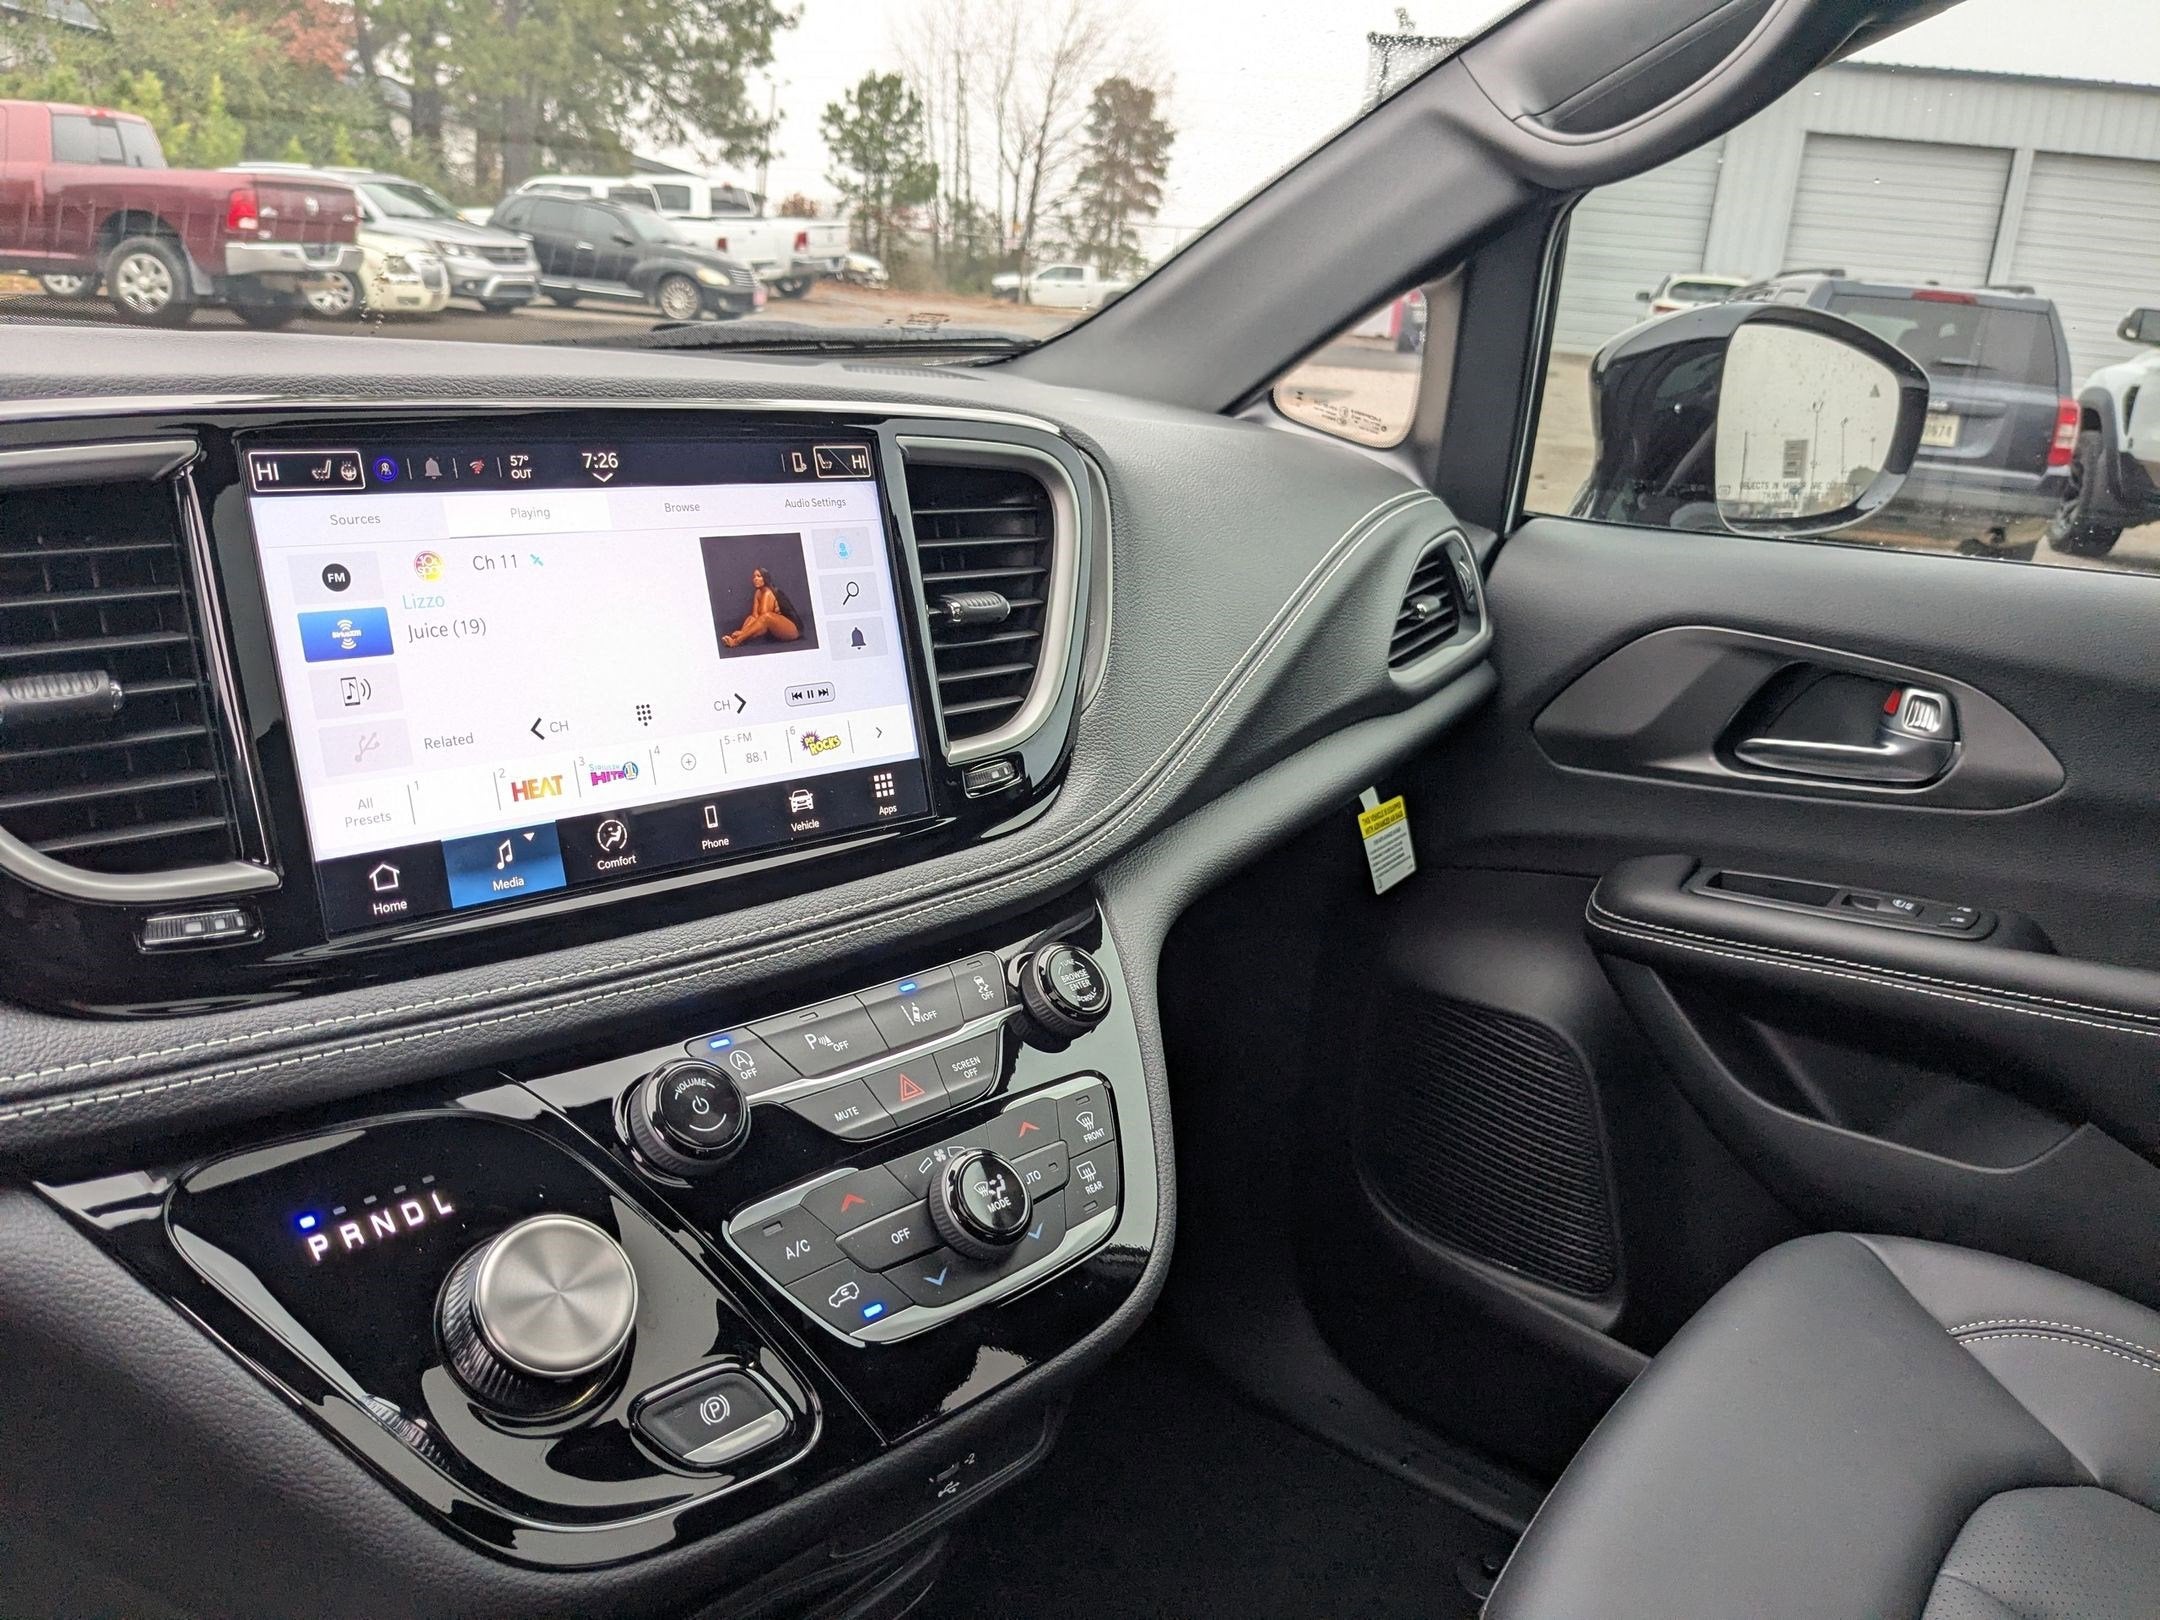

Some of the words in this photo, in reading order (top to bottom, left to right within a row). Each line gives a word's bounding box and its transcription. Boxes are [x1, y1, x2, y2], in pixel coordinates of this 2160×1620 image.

[582, 453, 619, 469] 7:26
[852, 455, 867, 469] HI
[256, 462, 280, 482] HI
[511, 468, 532, 480] OUT
[664, 502, 700, 513] Browse
[784, 498, 810, 508] Audio
[812, 496, 847, 509] Settings
[329, 513, 381, 526] Sources
[510, 507, 551, 520] Playing
[472, 555, 495, 570] Ch
[500, 554, 518, 568] 11
[327, 572, 346, 583] FM
[403, 595, 445, 610] Lizzo
[407, 622, 449, 643] Juice
[453, 617, 487, 639] (19)
[713, 700, 731, 712] CH
[550, 720, 569, 733] CH
[424, 733, 474, 750] Related
[745, 751, 768, 764] 88.1
[511, 775, 563, 802] HEAT
[357, 798, 374, 810] All
[879, 804, 897, 817] Apps
[344, 812, 392, 828] Presets
[791, 819, 819, 833] Vehicle
[702, 837, 729, 850] Phone
[597, 854, 637, 870] Comfort
[493, 876, 525, 891] Media
[373, 899, 408, 915] Home
[1060, 968, 1089, 982] BROWSE
[1068, 980, 1092, 992] ENTER
[980, 991, 995, 1001] OFF
[924, 1010, 938, 1022] OFF
[833, 1040, 849, 1052] OFF
[951, 1055, 981, 1072] SCREEN
[740, 1067, 758, 1080] OFF
[963, 1067, 979, 1079] OFF
[674, 1077, 707, 1095] VOLUME
[834, 1106, 860, 1122] MUTE
[1083, 1127, 1106, 1144] FRONT
[1084, 1180, 1104, 1196] REAR
[987, 1196, 1012, 1214] MODE
[890, 1227, 911, 1245] OFF
[785, 1239, 811, 1260] A/C
